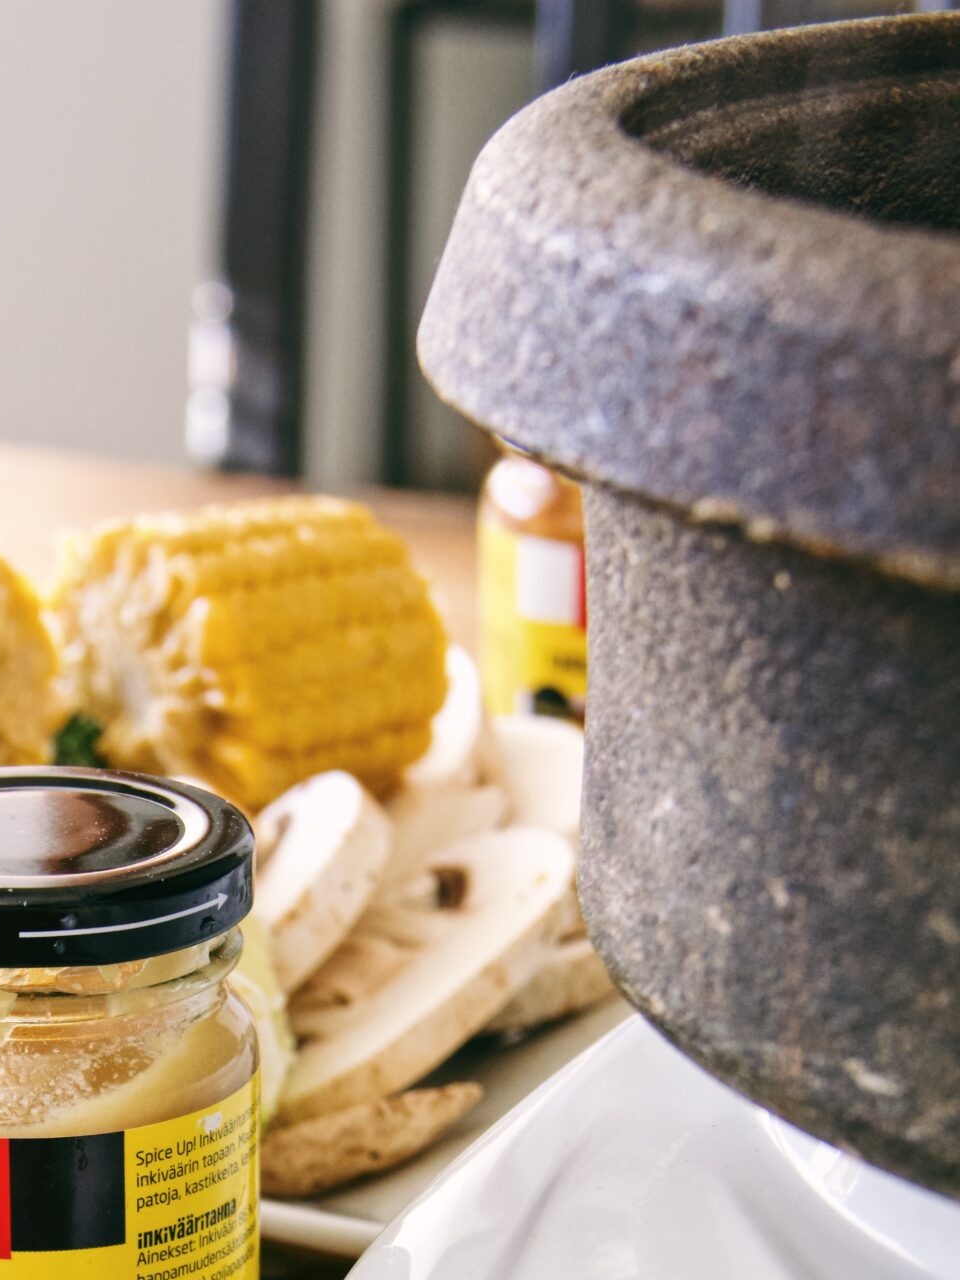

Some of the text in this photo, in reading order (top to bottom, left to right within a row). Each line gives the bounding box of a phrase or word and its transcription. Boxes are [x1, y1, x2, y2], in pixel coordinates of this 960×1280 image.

[136, 1147, 173, 1167] Spice
[177, 1136, 197, 1156] Up!
[136, 1161, 199, 1187] inkiväärin
[136, 1187, 181, 1212] patoja,
[137, 1239, 196, 1267] Ainekset:
